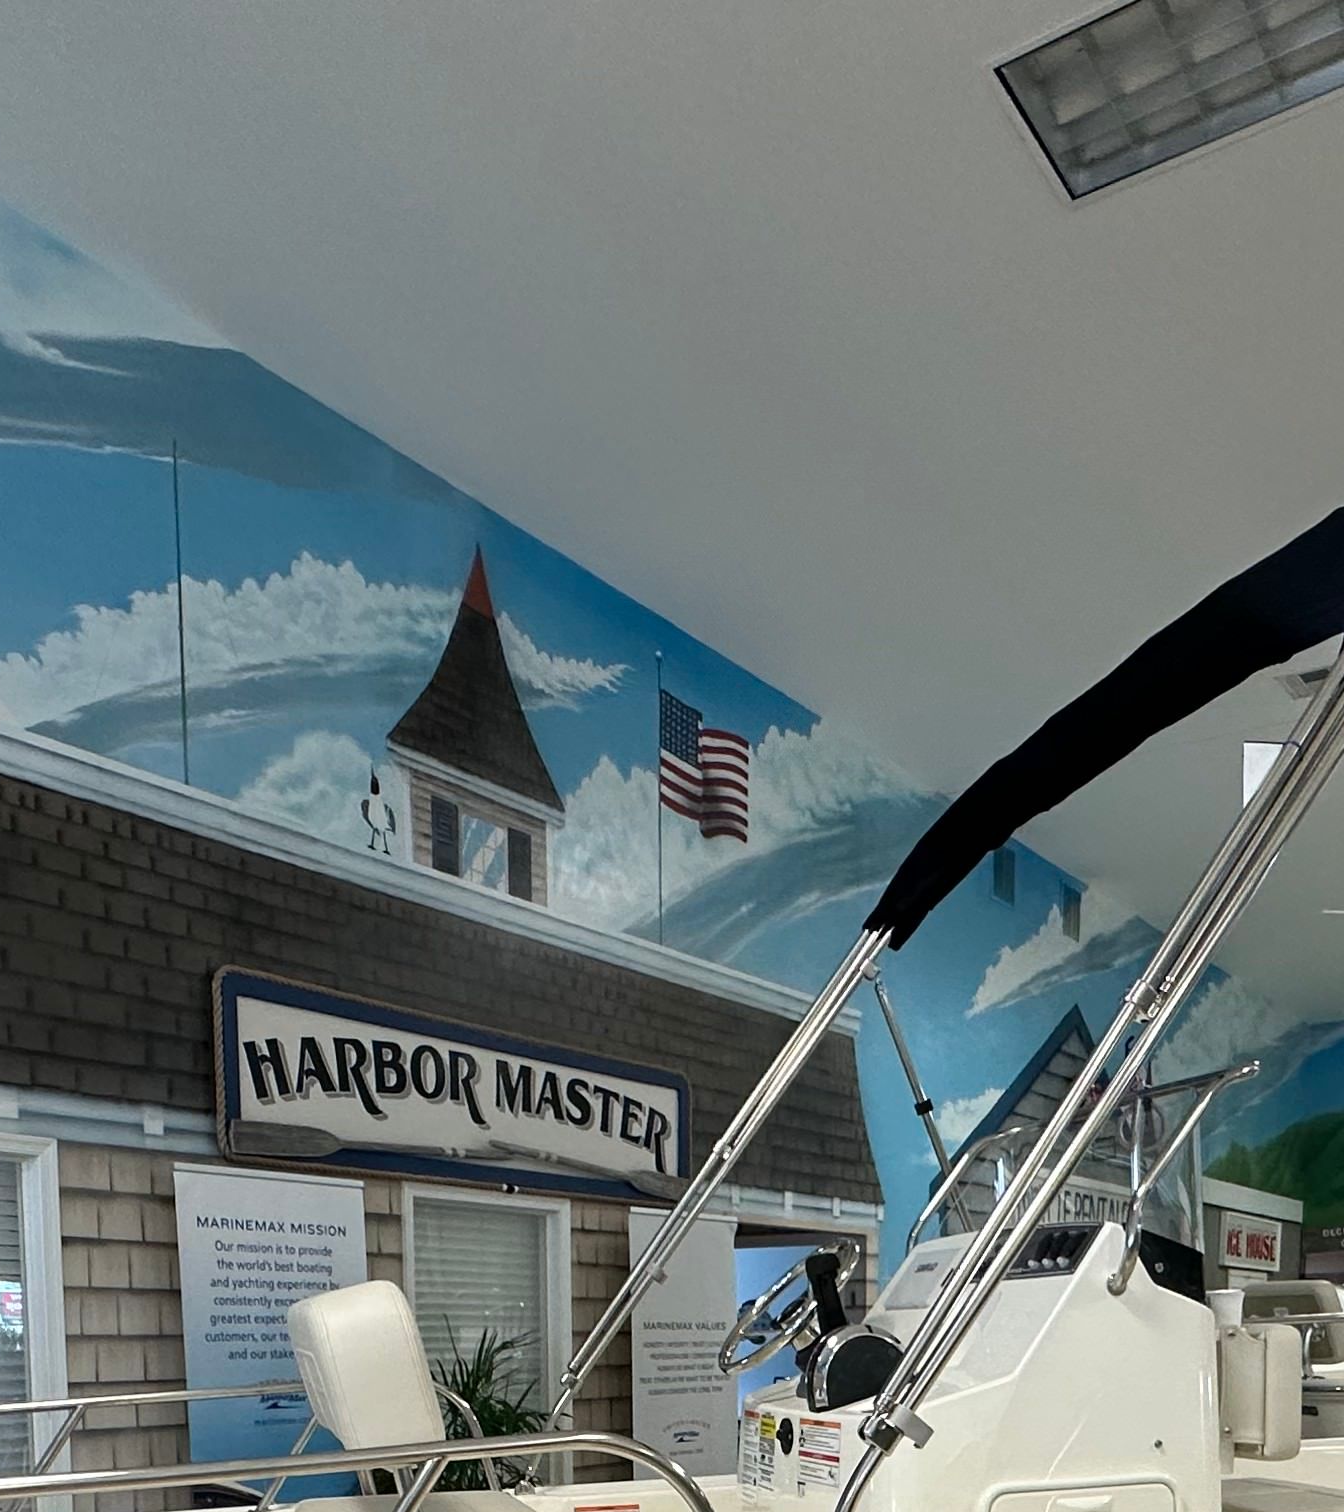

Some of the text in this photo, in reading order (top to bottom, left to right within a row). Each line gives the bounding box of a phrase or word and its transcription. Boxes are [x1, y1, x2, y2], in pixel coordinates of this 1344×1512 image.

[243, 1037, 672, 1173] HARBOR MASTER
[196, 1215, 347, 1238] MARINEMAX MISSION
[214, 1239, 333, 1258] Our mission is to provide
[1226, 1228, 1277, 1262] ICE HOUSE
[217, 1259, 333, 1277] the world's best boating
[210, 1277, 229, 1288] and
[232, 1278, 275, 1292] yachting
[277, 1279, 327, 1292] experience
[214, 1295, 272, 1309] consistently
[209, 1314, 288, 1327] greatest expect
[643, 1321, 727, 1331] MARINEMAX VALUES
[205, 1332, 258, 1343] customers,
[260, 1333, 277, 1343] our
[228, 1349, 248, 1360] and
[250, 1350, 268, 1360] our
